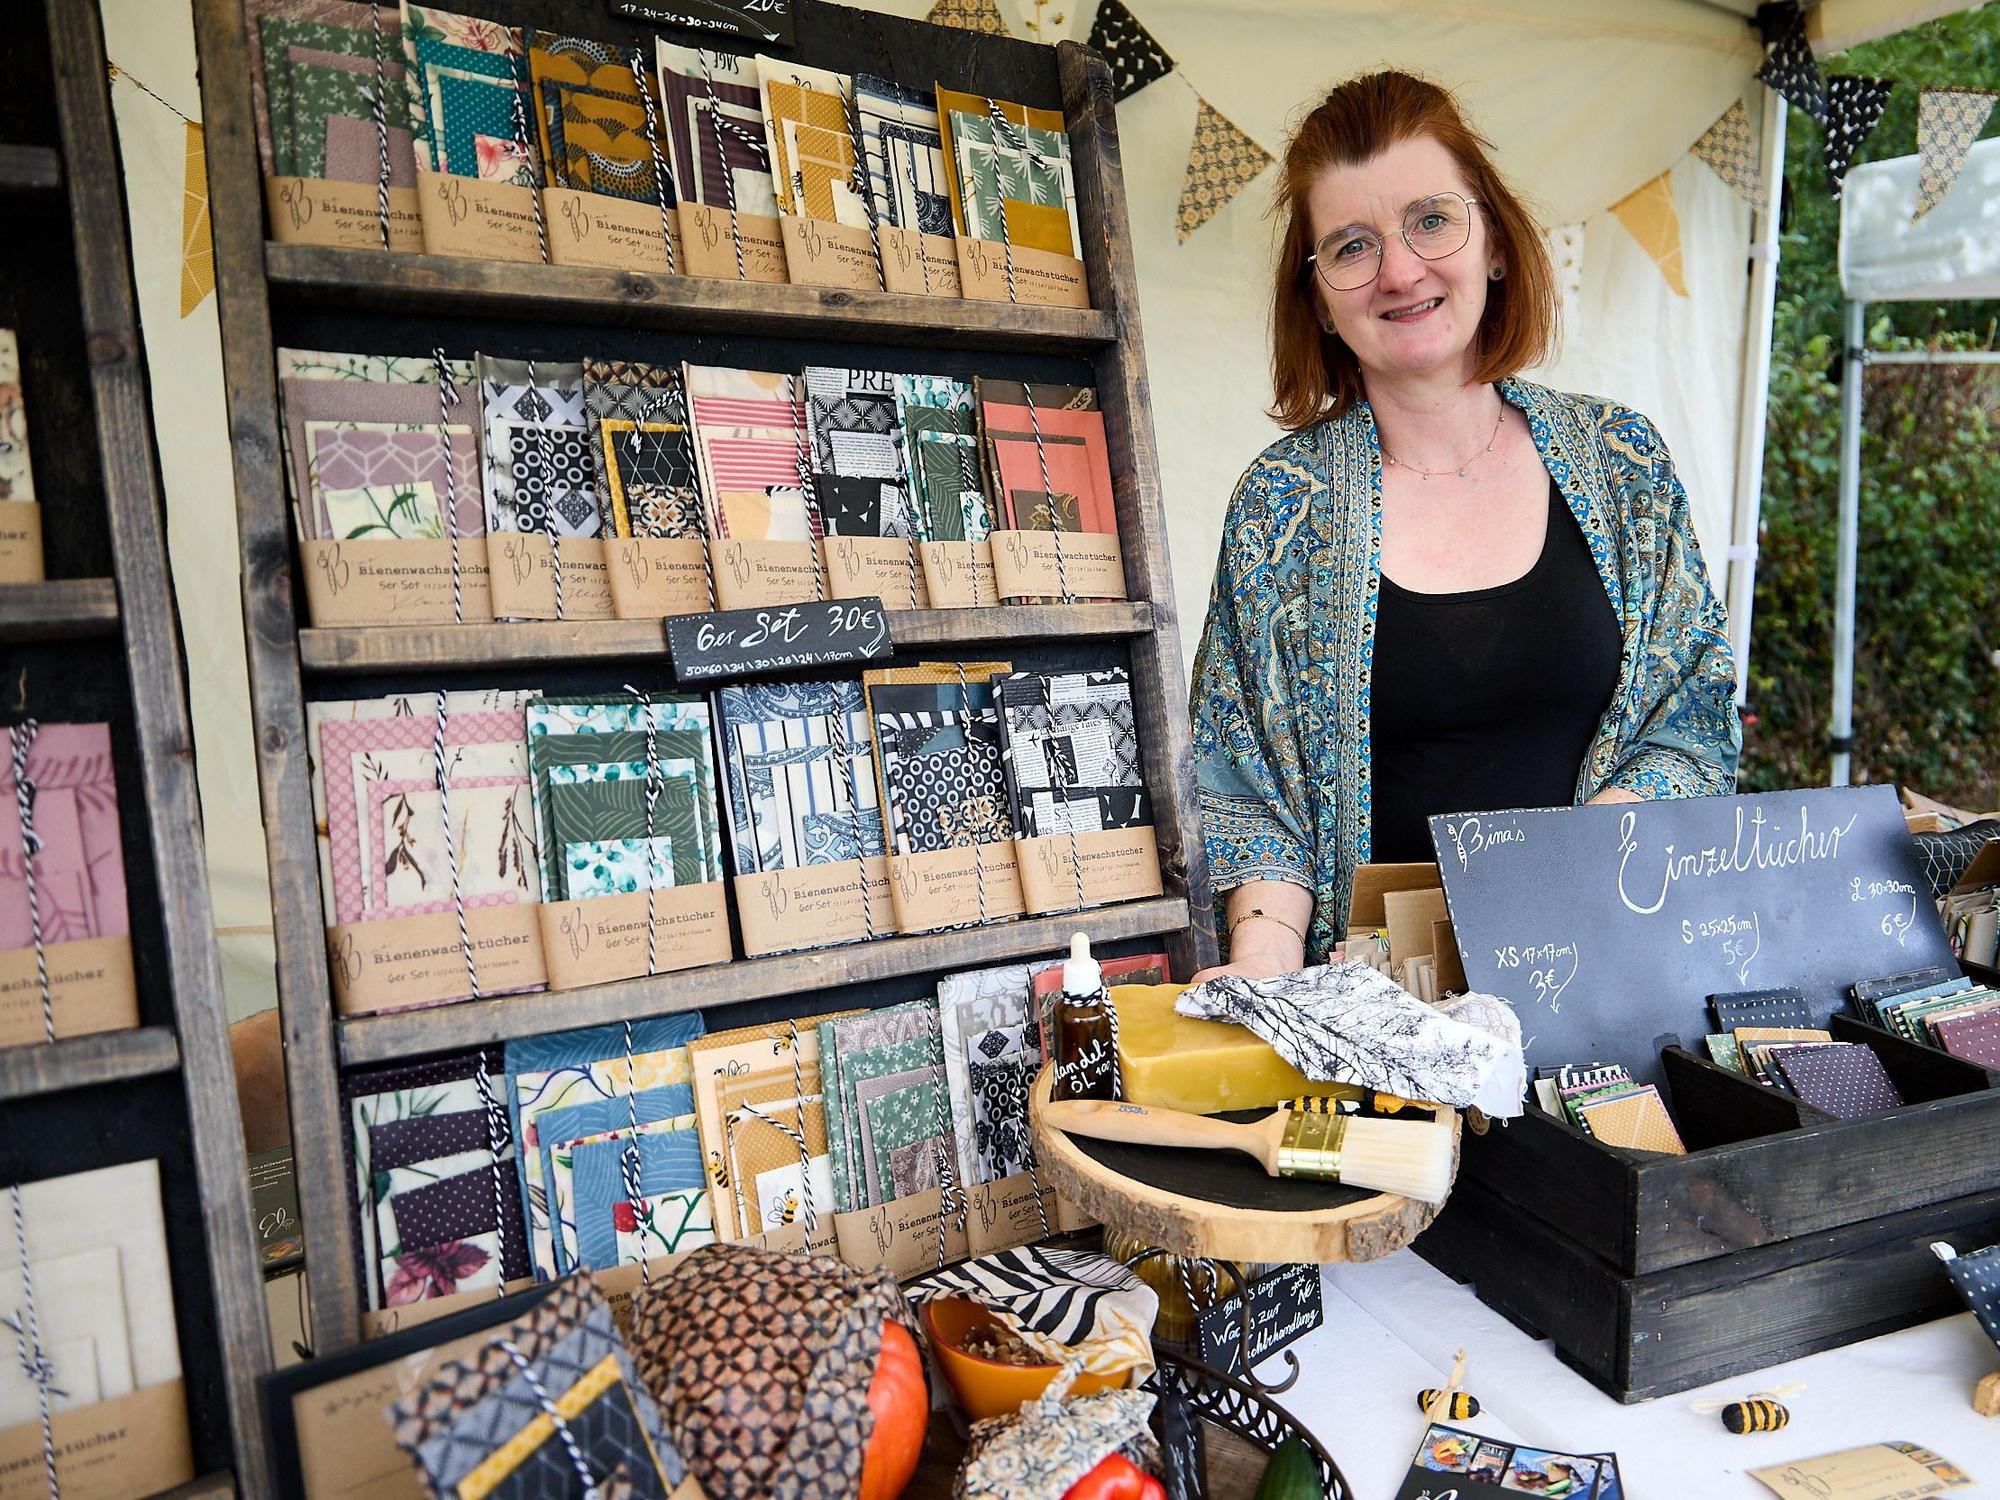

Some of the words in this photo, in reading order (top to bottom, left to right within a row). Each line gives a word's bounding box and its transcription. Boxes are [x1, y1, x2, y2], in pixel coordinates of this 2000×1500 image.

[625, 237, 642, 247] Set
[755, 249, 770, 259] Set
[837, 254, 850, 264] 5er
[851, 256, 864, 267] Set
[379, 580, 397, 591] 5er
[401, 580, 420, 590] Set
[569, 574, 587, 584] Set
[666, 575, 681, 585] 5er
[682, 575, 699, 585] Set
[766, 576, 780, 586] 5er
[781, 577, 795, 586] Set
[697, 623, 737, 652] 6er
[740, 607, 809, 648] Set
[827, 605, 877, 638] 30€
[1617, 805, 1858, 915] Einzeltücher
[798, 902, 815, 913] 6er
[816, 900, 832, 910] Set
[1881, 912, 1908, 935] 6€
[1682, 918, 1694, 945] S
[605, 939, 623, 950] 6er
[624, 935, 641, 946] Set
[1494, 948, 1520, 969] XS
[1722, 940, 1748, 967] 5€
[387, 972, 406, 984] 6er
[410, 968, 430, 979] Set
[1528, 969, 1561, 1004] 3€
[1008, 1209, 1021, 1220] 6er
[1022, 1206, 1036, 1216] Set
[912, 1228, 926, 1242] 5er
[926, 1225, 940, 1236] Set
[1211, 1317, 1256, 1347] Wacs
[1257, 1302, 1282, 1324] zur
